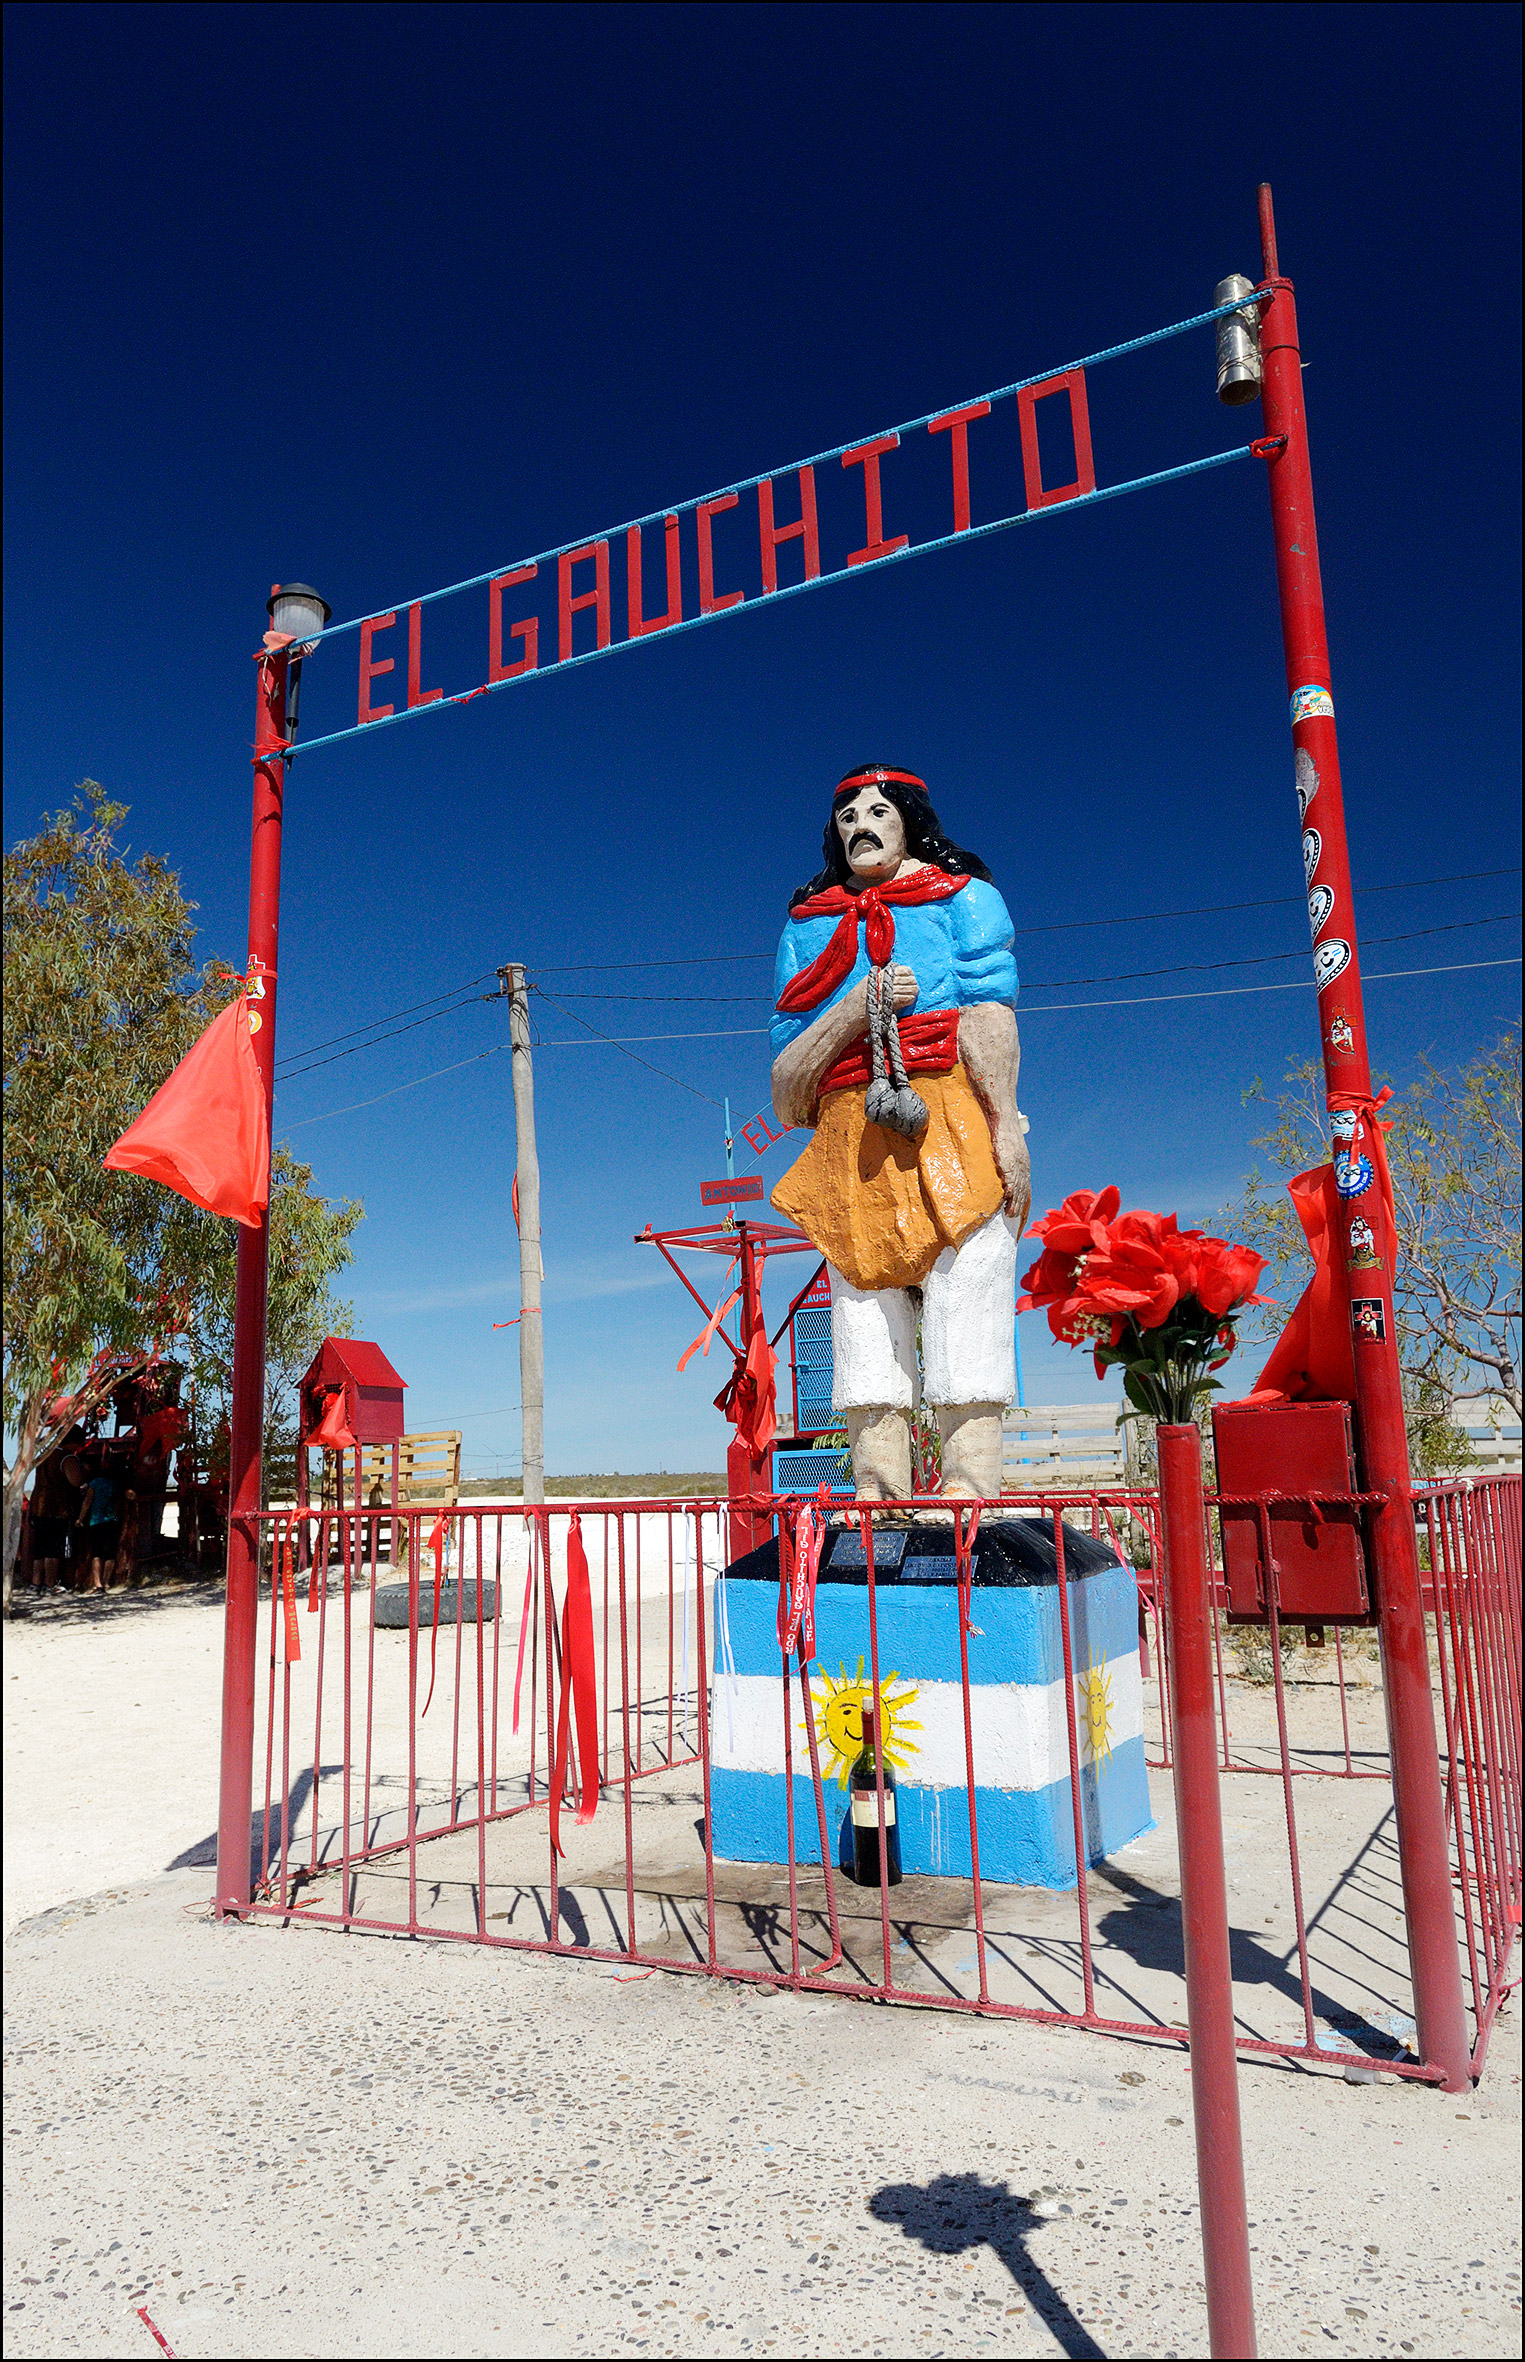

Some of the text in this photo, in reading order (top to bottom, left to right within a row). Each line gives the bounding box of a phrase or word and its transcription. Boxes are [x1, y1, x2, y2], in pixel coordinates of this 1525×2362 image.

[358, 365, 1096, 727] EL GAUCHITO
[740, 1114, 784, 1156] EL
[704, 1183, 761, 1201] ANTONIO
[816, 1280, 828, 1289] EL
[286, 1570, 294, 1603] ENVIDIA
[794, 1551, 808, 1610] GAUCHITO
